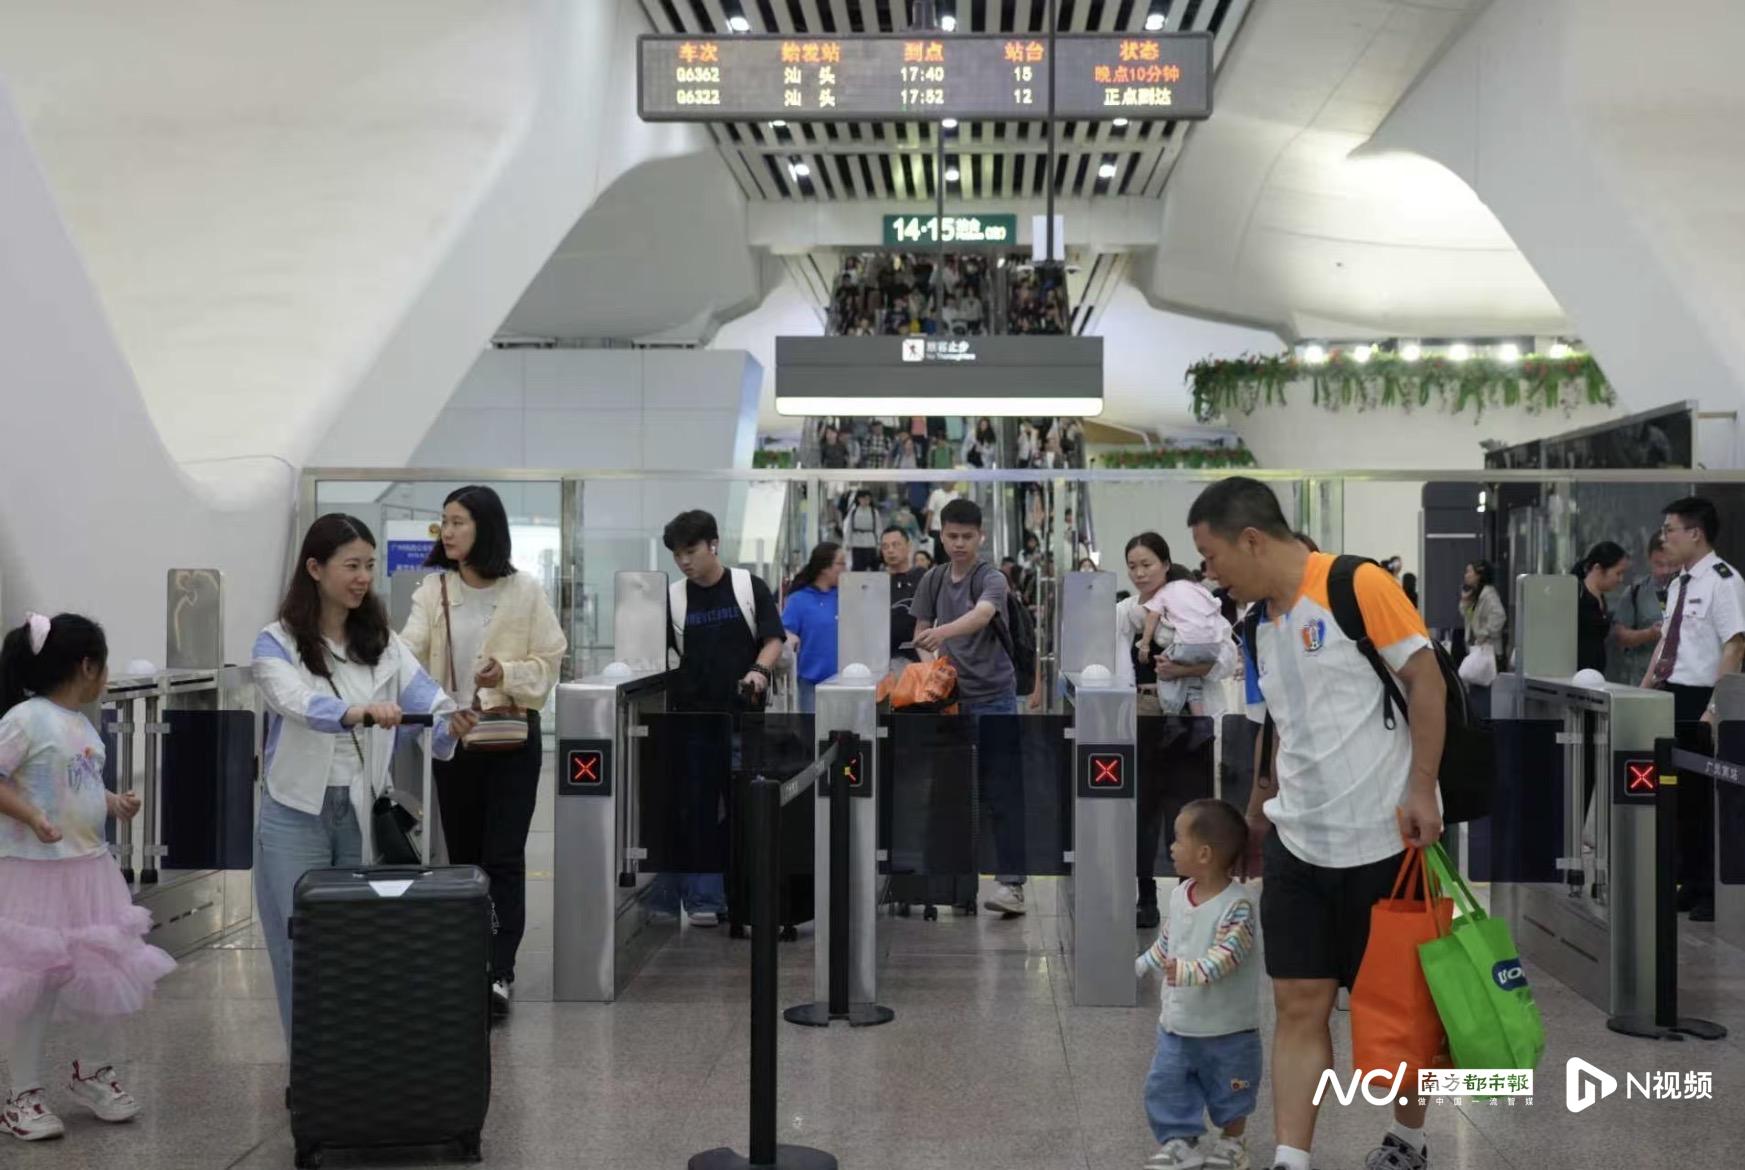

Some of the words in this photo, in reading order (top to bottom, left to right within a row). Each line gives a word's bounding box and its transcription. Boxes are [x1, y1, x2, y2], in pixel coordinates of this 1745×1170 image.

[680, 42, 718, 62] 车次
[906, 42, 943, 61] 到点
[1006, 42, 1044, 61] 站台
[1121, 40, 1160, 61] 状态
[901, 66, 944, 82] 17:40
[1014, 66, 1032, 82] 15
[1095, 65, 1180, 82] 晚点10分钟
[1014, 89, 1032, 104] 12
[1104, 87, 1171, 105] 正点到达
